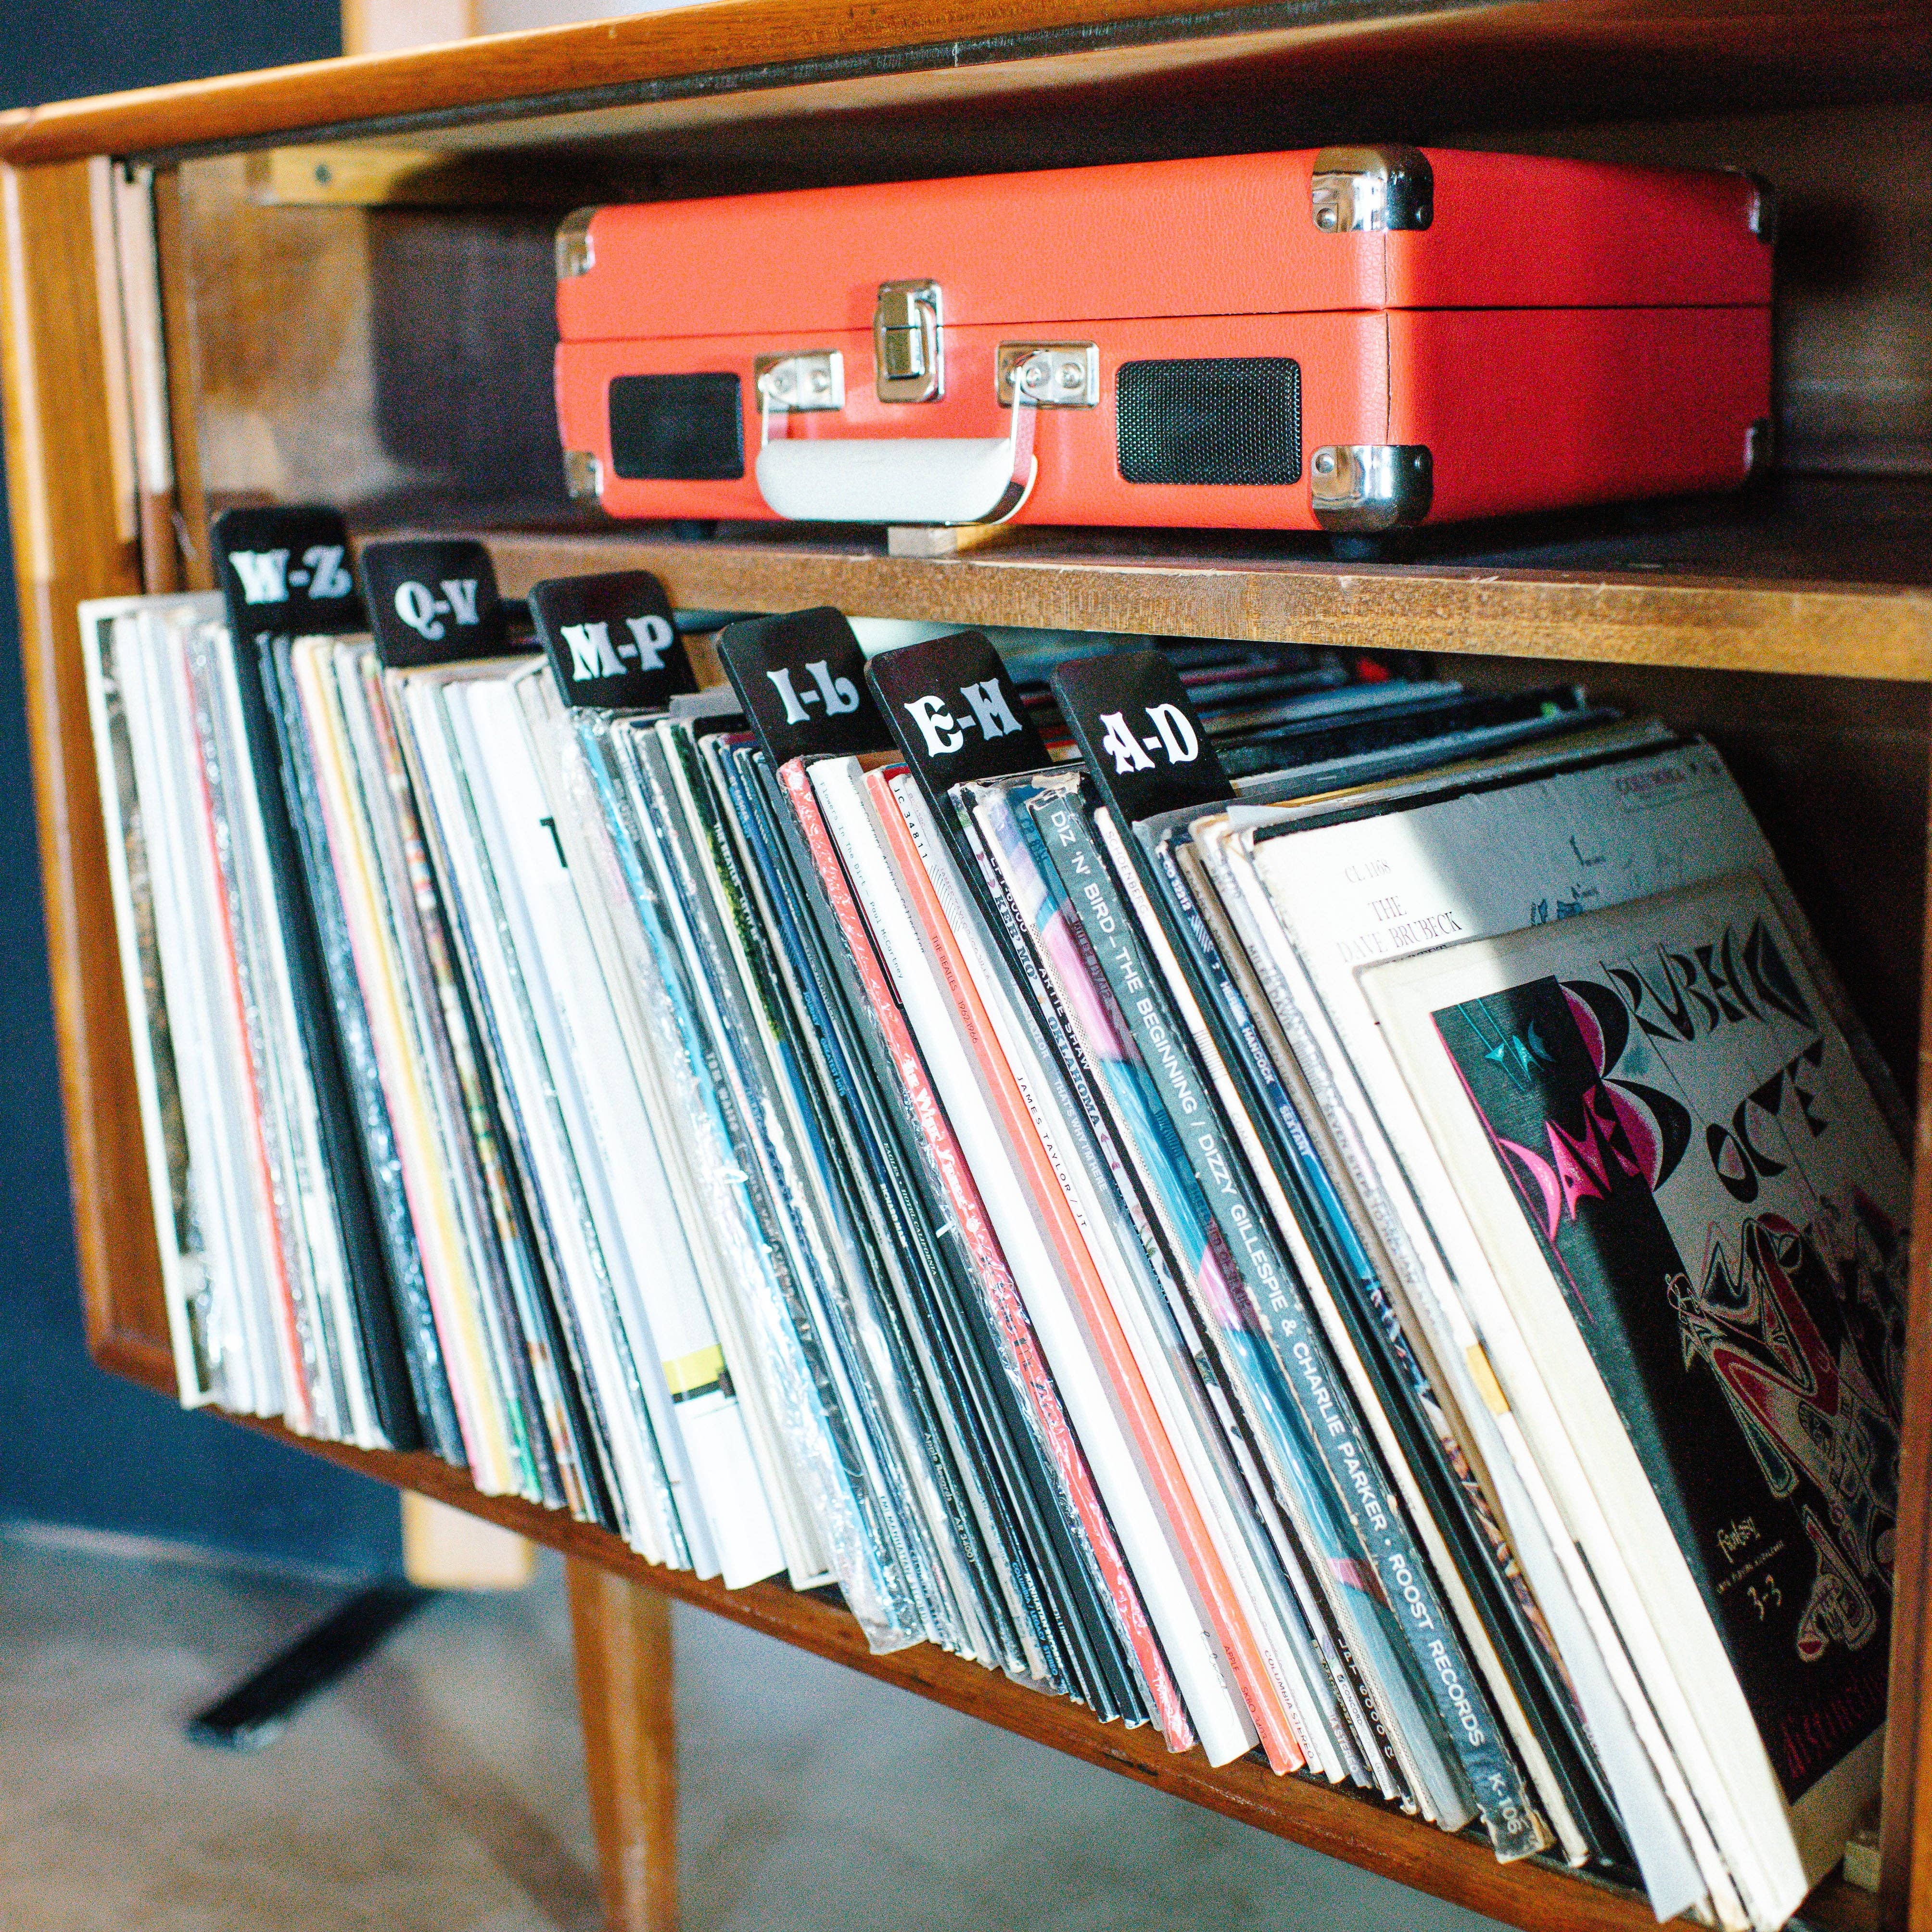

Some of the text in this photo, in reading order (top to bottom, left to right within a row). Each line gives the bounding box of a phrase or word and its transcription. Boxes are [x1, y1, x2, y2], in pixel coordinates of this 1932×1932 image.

[229, 545, 352, 605] W-Z
[394, 579, 479, 640] Q-V
[560, 615, 674, 681] M-P
[904, 677, 1023, 758] E-H
[1100, 703, 1198, 775] A-D
[712, 822, 725, 841] THE
[903, 811, 928, 859] 34811
[1105, 829, 1150, 915] SCHOENBERG
[1345, 859, 1391, 883] CL 1168
[819, 781, 839, 821] Flowers
[838, 826, 847, 837] In
[844, 841, 855, 859] The
[853, 863, 866, 887] Dirt
[868, 901, 882, 924] Paul
[878, 928, 904, 979] McCartney
[1368, 895, 1408, 922] THE
[931, 935, 943, 953] THE
[939, 955, 958, 991] BEATLES
[1335, 932, 1390, 963] DAVE
[1387, 911, 1463, 950] BRUBECK
[802, 991, 820, 1026] JOURNEY
[819, 1037, 839, 1077] GREATEST
[834, 1077, 845, 1096] HITS
[993, 893, 1102, 1127] KEB' MO' OKLAHOMA
[1038, 966, 1091, 1072] ARTIE SHAW
[1268, 988, 1294, 1032] DAVIS
[1241, 1025, 1276, 1085] HANCOCK
[1278, 1104, 1310, 1157] SEXTANT
[1017, 1075, 1043, 1125] JAMES
[1042, 1132, 1072, 1192] TAYLOR
[1053, 1078, 1076, 1118] THAT'S
[1069, 1117, 1088, 1144] WHY
[1080, 1143, 1095, 1162] I'M
[1088, 1161, 1108, 1192] HERE
[883, 1142, 938, 1276] EAGLES HOTEL CALIFORNIA
[1049, 809, 1077, 847] DIZ
[1082, 882, 1117, 935] BIRD
[1112, 945, 1144, 994] THE
[1135, 996, 1199, 1115] BEGINNING
[1196, 1132, 1237, 1199] DIZZY
[1228, 1202, 1289, 1313] GILLESPIE
[1280, 1315, 1300, 1337] &
[1290, 1339, 1346, 1438] CHARLIE
[1336, 1440, 1389, 1533] PARKER
[1387, 1551, 1435, 1635] ROOST
[1426, 1638, 1487, 1749] RECORDS
[922, 1431, 976, 1563] Apple Records AR 34001
[1011, 1561, 1031, 1604] COLUMBIA
[1029, 1609, 1046, 1642] LEGACY
[1042, 1644, 1059, 1677] STEREO
[1023, 1572, 1049, 1628] MANHATTAN
[1223, 1644, 1240, 1672] APPLE
[1240, 1685, 1257, 1713] SKBO
[1263, 1649, 1294, 1710] COLUMBIA
[1290, 1711, 1315, 1759] STEREO
